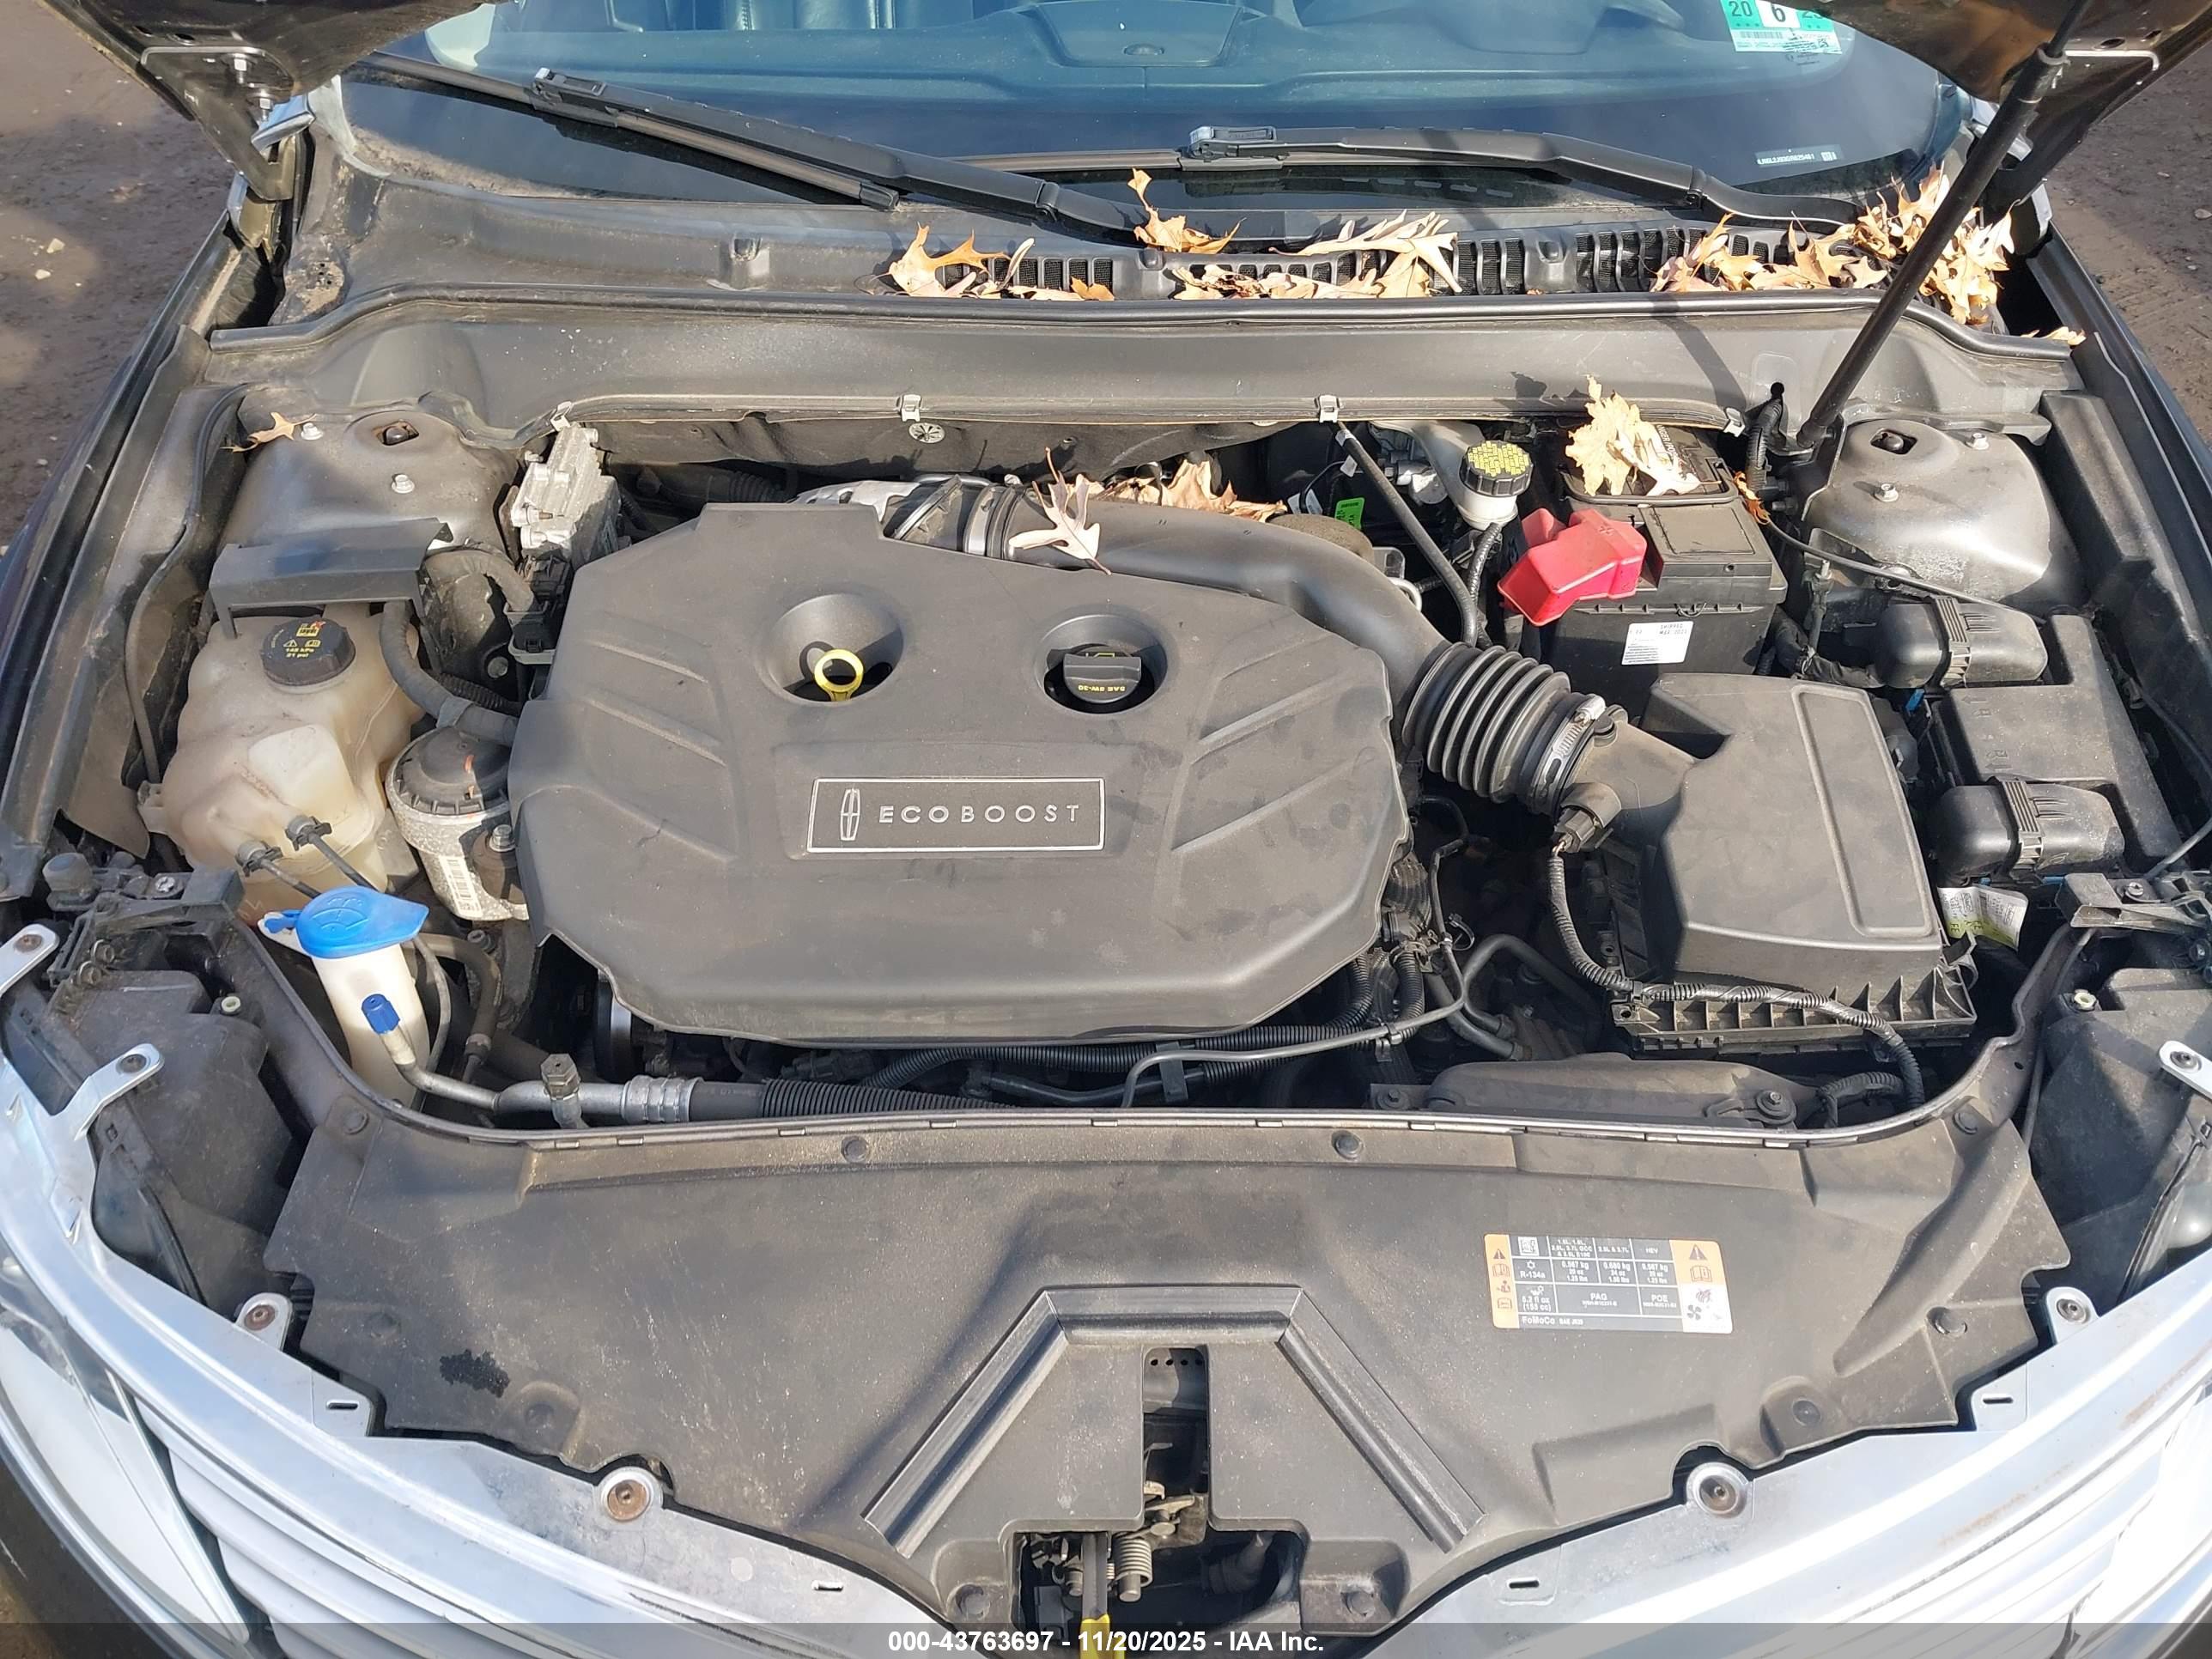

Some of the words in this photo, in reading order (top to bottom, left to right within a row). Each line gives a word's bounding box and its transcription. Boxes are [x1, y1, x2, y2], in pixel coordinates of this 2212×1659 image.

[1729, 1, 1753, 16] 20
[1771, 4, 1786, 21] 6
[879, 805, 1079, 823] ECOBOOST
[1520, 1270, 1546, 1279] R-134a
[1522, 1316, 1555, 1324] FoMoCo
